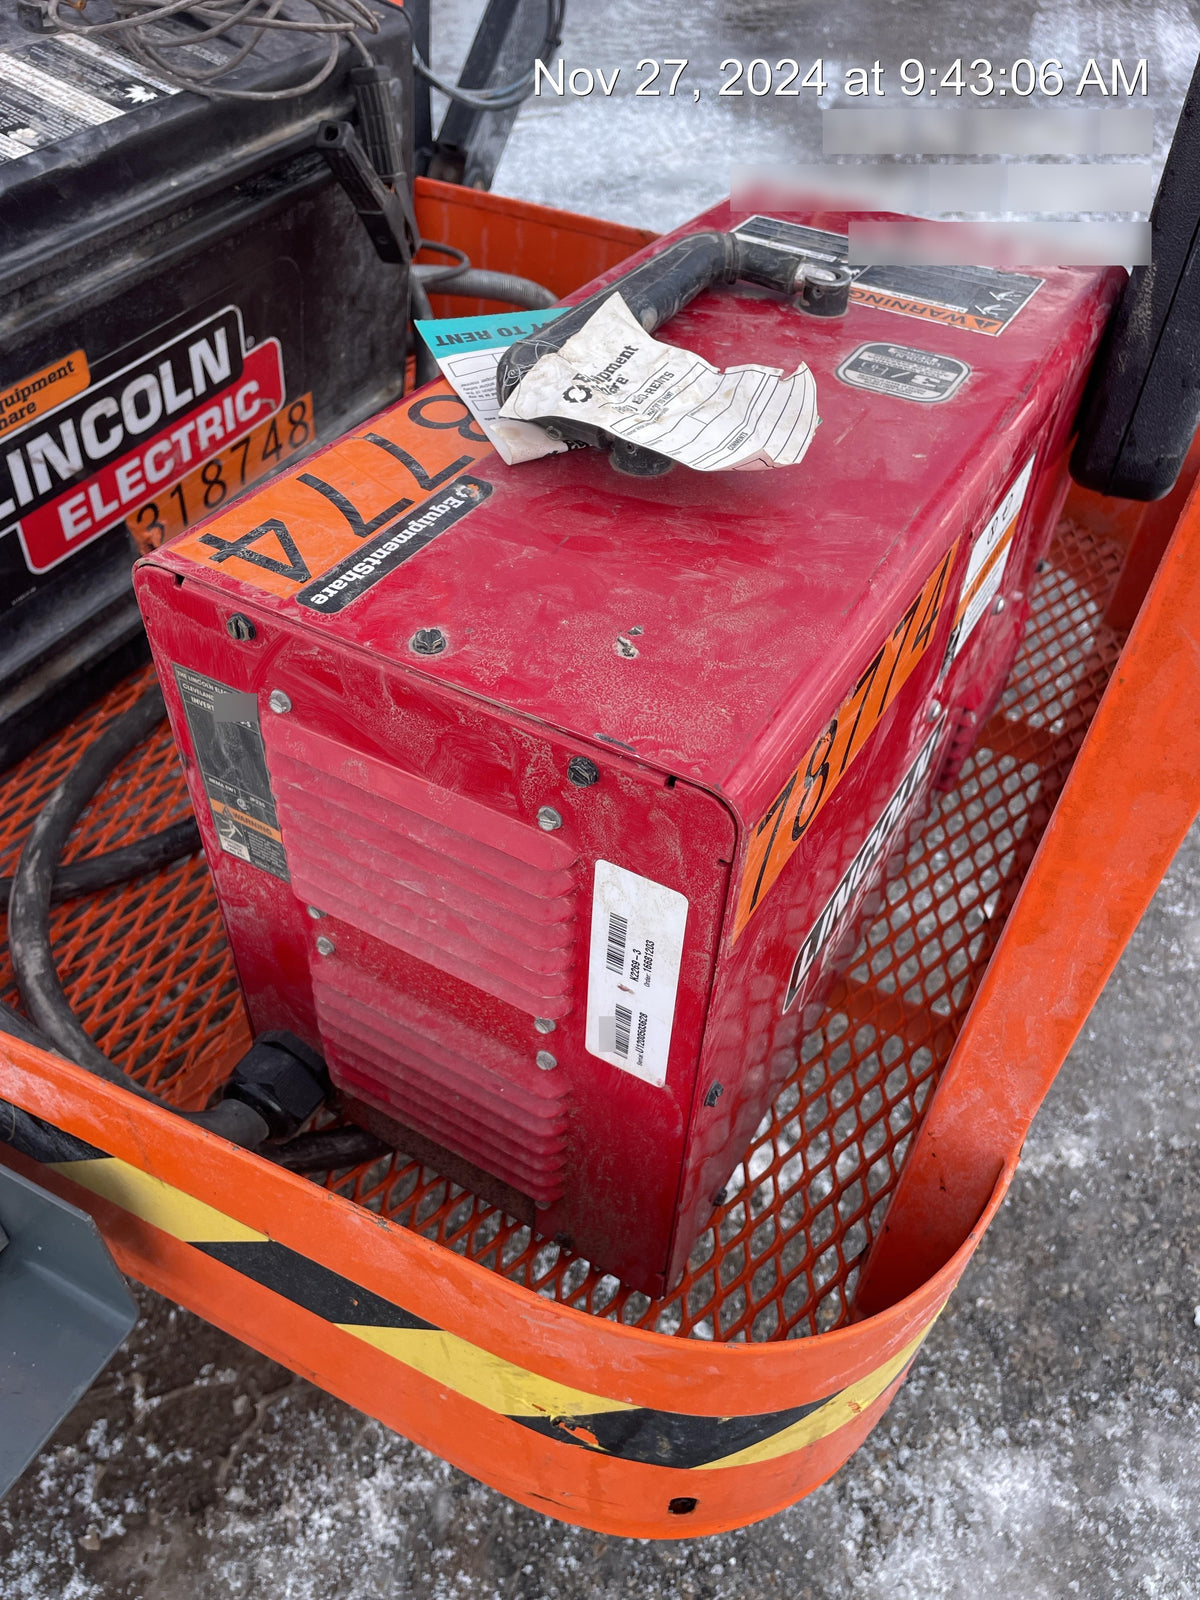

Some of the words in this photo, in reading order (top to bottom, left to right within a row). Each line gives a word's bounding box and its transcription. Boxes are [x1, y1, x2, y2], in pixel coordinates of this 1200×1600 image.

[850, 289, 967, 324] WARNING
[435, 330, 492, 347] RENT
[496, 326, 528, 337] TO
[0, 360, 75, 415] uipment
[0, 401, 37, 430] hare
[57, 379, 262, 542] ELECTRIC
[727, 431, 749, 451] COMMENTS
[136, 400, 310, 551] 318748
[310, 494, 467, 605] EquipmentShare
[190, 695, 215, 712] INVERT
[750, 550, 952, 914] 78774
[795, 733, 939, 988] LINCOLN
